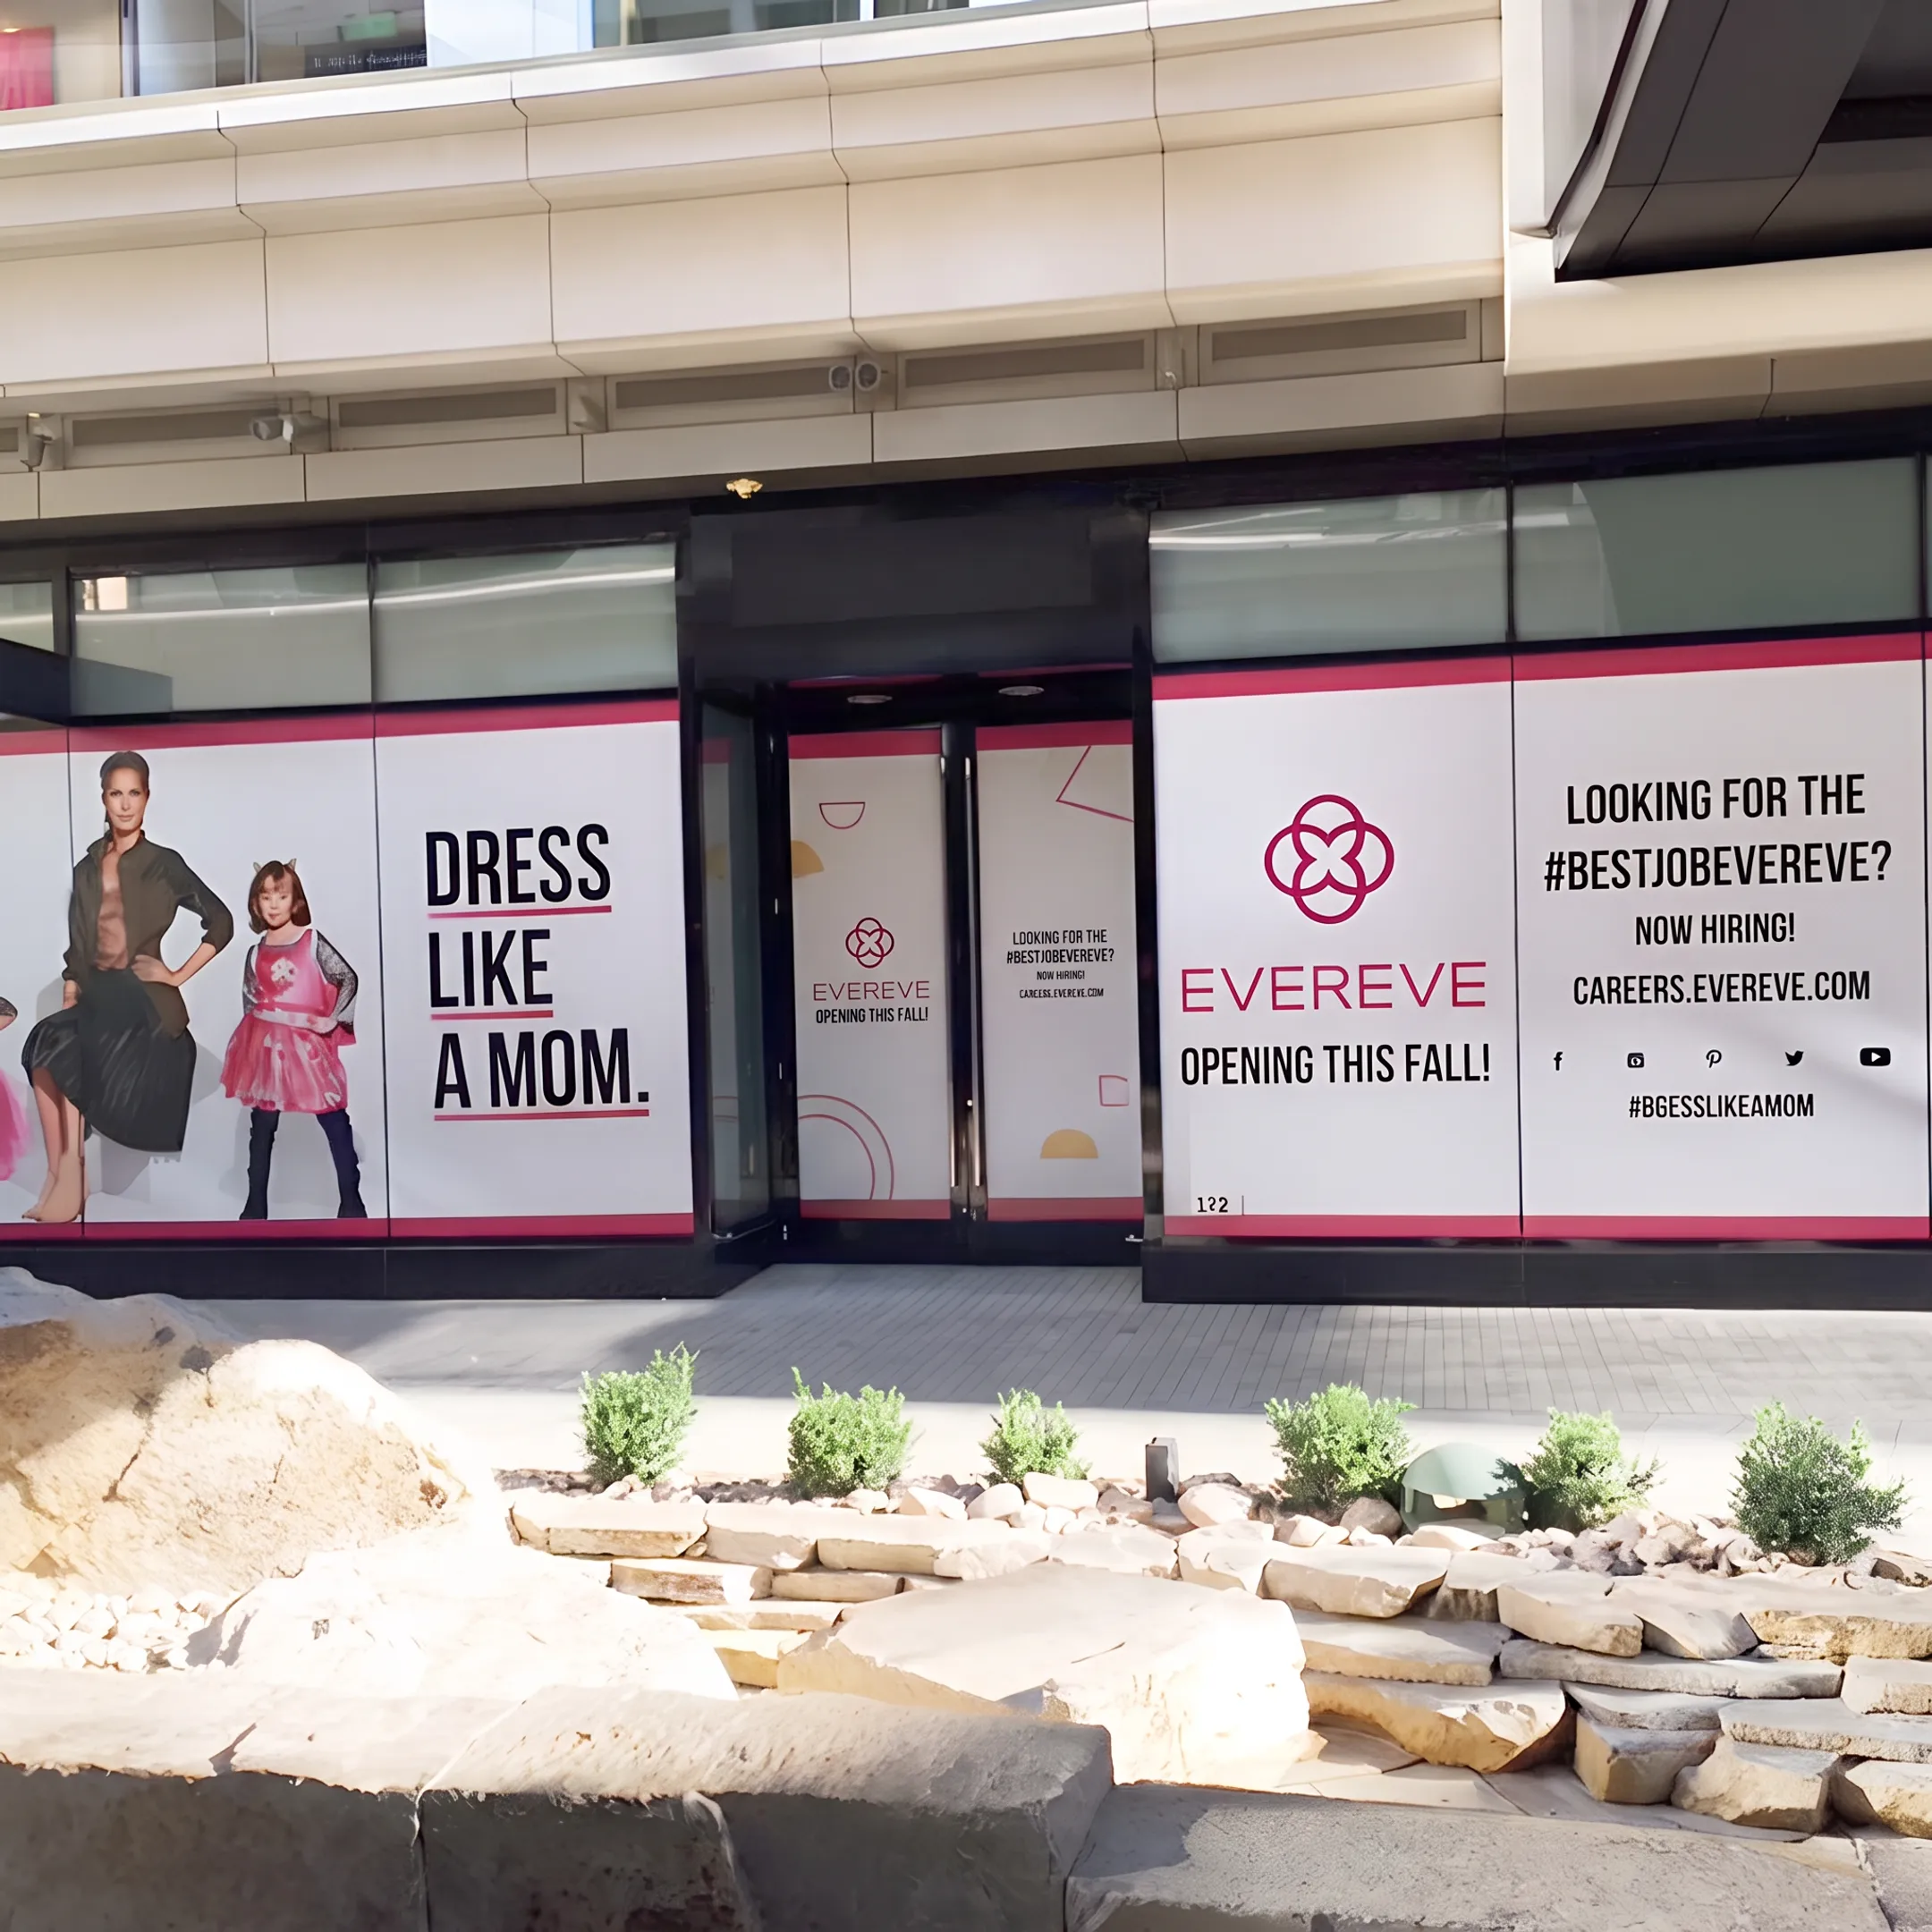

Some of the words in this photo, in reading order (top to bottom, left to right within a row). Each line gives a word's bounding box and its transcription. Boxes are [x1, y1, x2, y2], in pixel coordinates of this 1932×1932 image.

[1567, 779, 1711, 825] LOOKING
[1723, 776, 1787, 819] FOR
[1797, 773, 1866, 816] THE
[425, 823, 612, 908] DRESS
[1544, 840, 1892, 892] #BESTJOBEVEREVE?
[1013, 930, 1060, 945] LOOKING
[1063, 929, 1083, 944] FOR
[1086, 928, 1108, 944] THE
[1635, 914, 1693, 945] NOW
[1701, 911, 1795, 945] HIRING!
[428, 928, 553, 1008] LIKE
[1037, 970, 1055, 980] NOW
[1055, 970, 1085, 980] HIRING!
[1182, 962, 1487, 1013] EVEREVE
[1573, 970, 1870, 1005] CAREERS.EVEREVE.COM
[813, 980, 930, 1002] EVEREVE
[816, 1008, 866, 1024] OPENING
[869, 1007, 894, 1022] THIS
[897, 1006, 928, 1021] FALL!
[434, 1032, 472, 1109] A
[487, 1028, 649, 1108] MOM.
[1181, 1045, 1313, 1086] OPENING
[1322, 1044, 1394, 1083] THIS
[1405, 1043, 1490, 1082] FALL!
